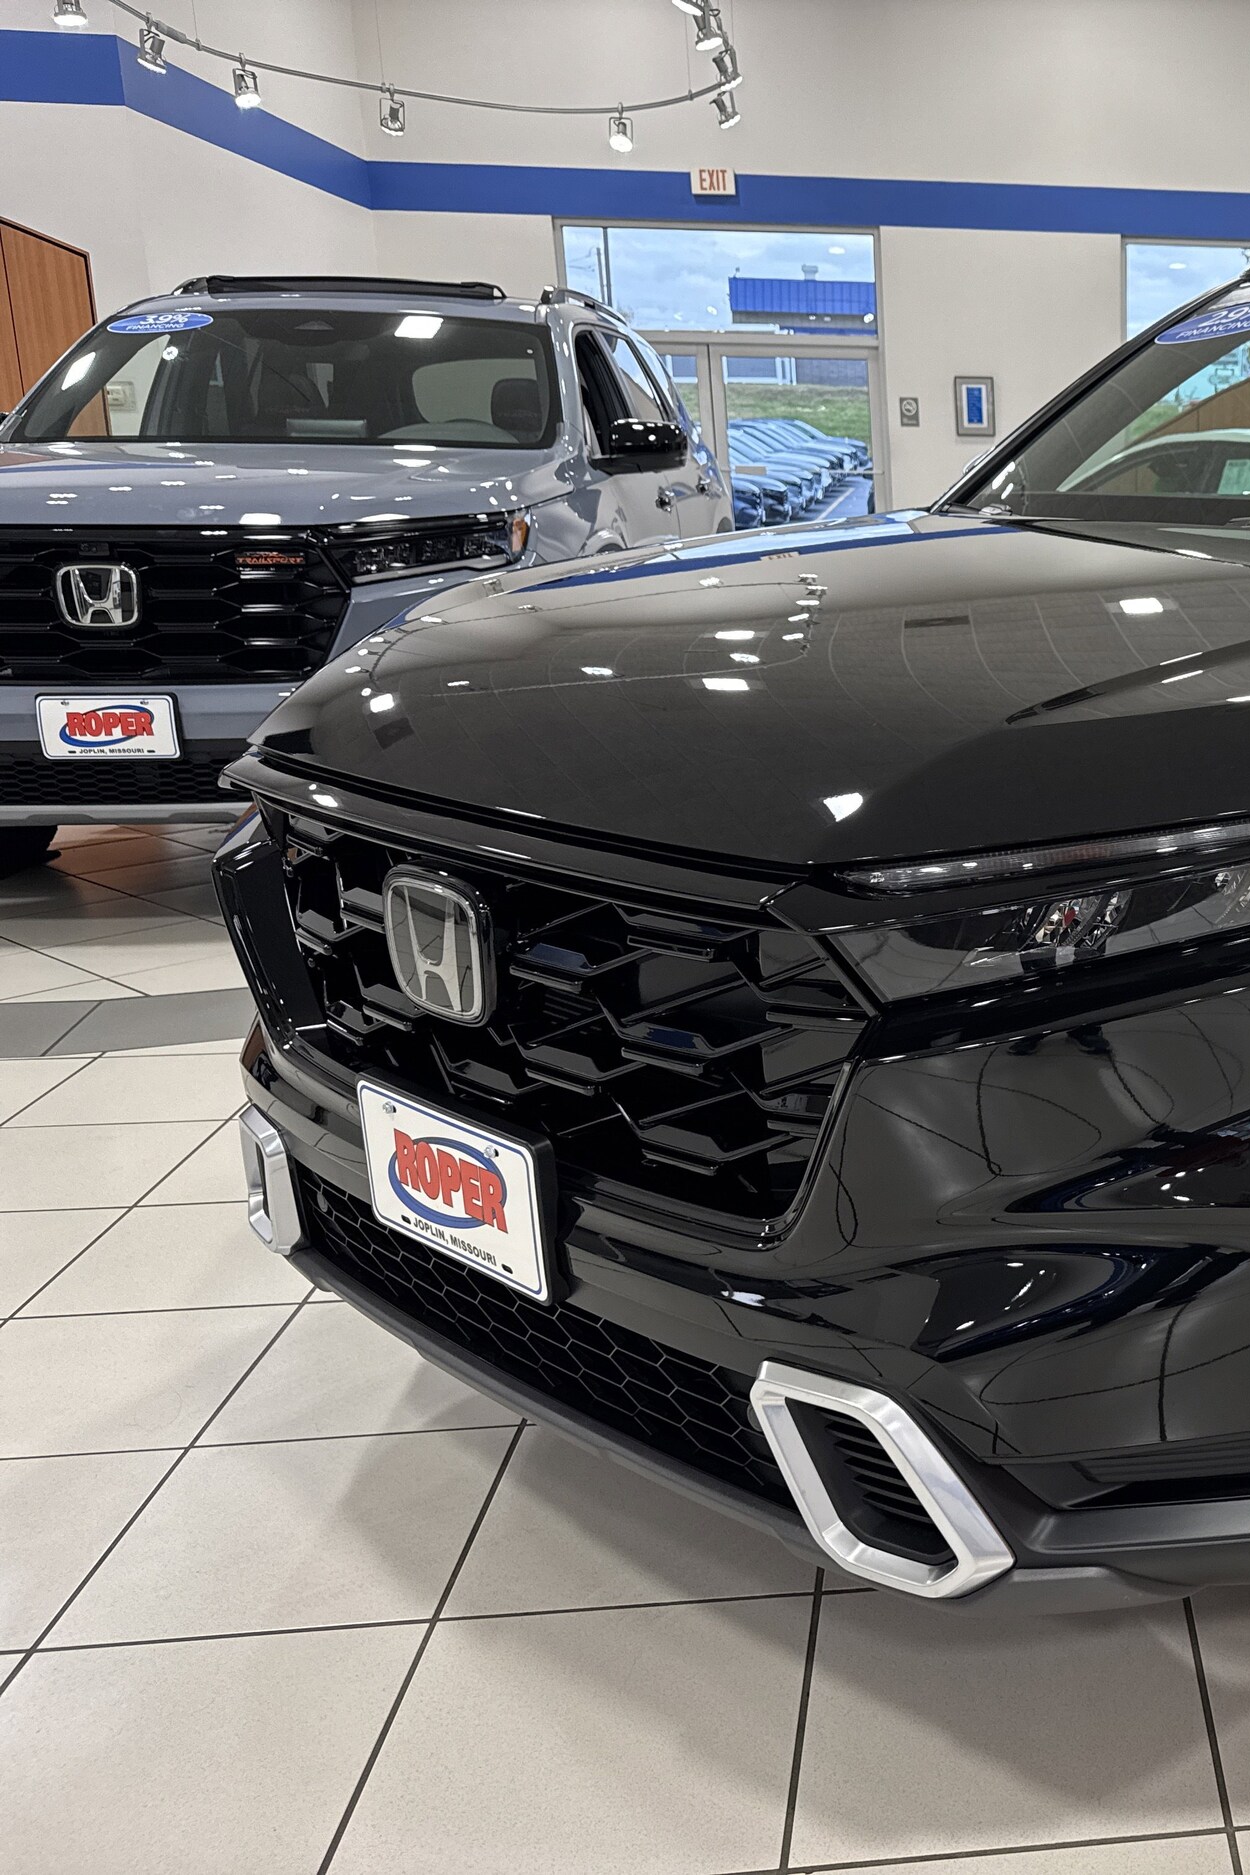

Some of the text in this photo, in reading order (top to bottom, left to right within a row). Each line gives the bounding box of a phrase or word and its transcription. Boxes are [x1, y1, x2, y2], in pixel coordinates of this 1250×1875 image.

[699, 169, 727, 191] EXIT
[126, 323, 184, 331] FINANCING
[236, 557, 304, 565] TRAILSPORT
[66, 712, 154, 737] ROPER
[394, 1128, 508, 1234] ROPER
[413, 1217, 497, 1266] JOPLIN, MISSOURI
